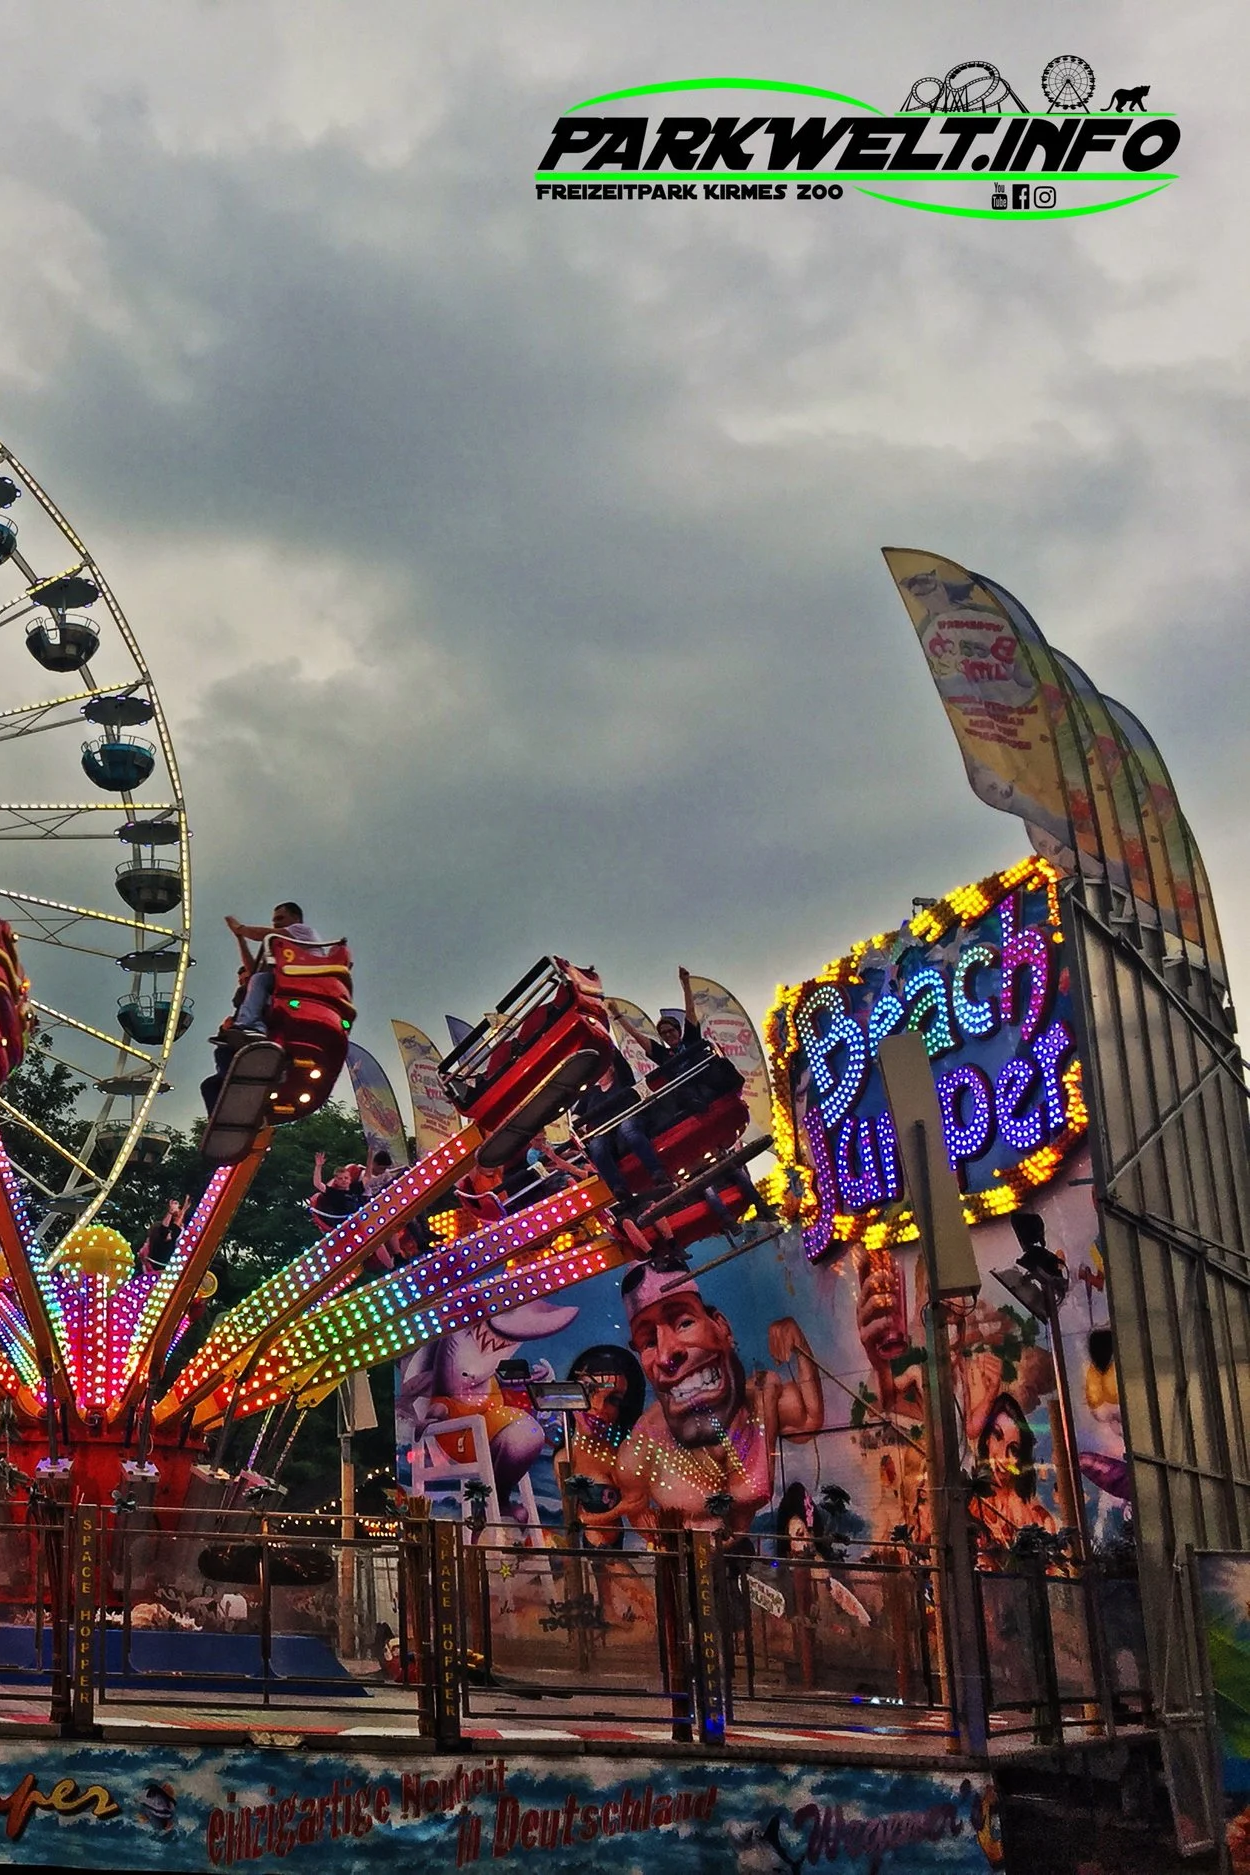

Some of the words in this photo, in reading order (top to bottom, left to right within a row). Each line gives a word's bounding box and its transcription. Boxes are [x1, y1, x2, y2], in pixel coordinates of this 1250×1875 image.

[282, 949, 295, 964] 9
[796, 894, 1048, 1129] Beach
[80, 1519, 93, 1594] SPACE
[79, 1610, 92, 1704] HOPPER
[206, 1779, 391, 1866] einzigartige
[400, 1758, 510, 1820] Neuheit
[455, 1807, 482, 1867] in
[492, 1785, 719, 1859] Deutschland
